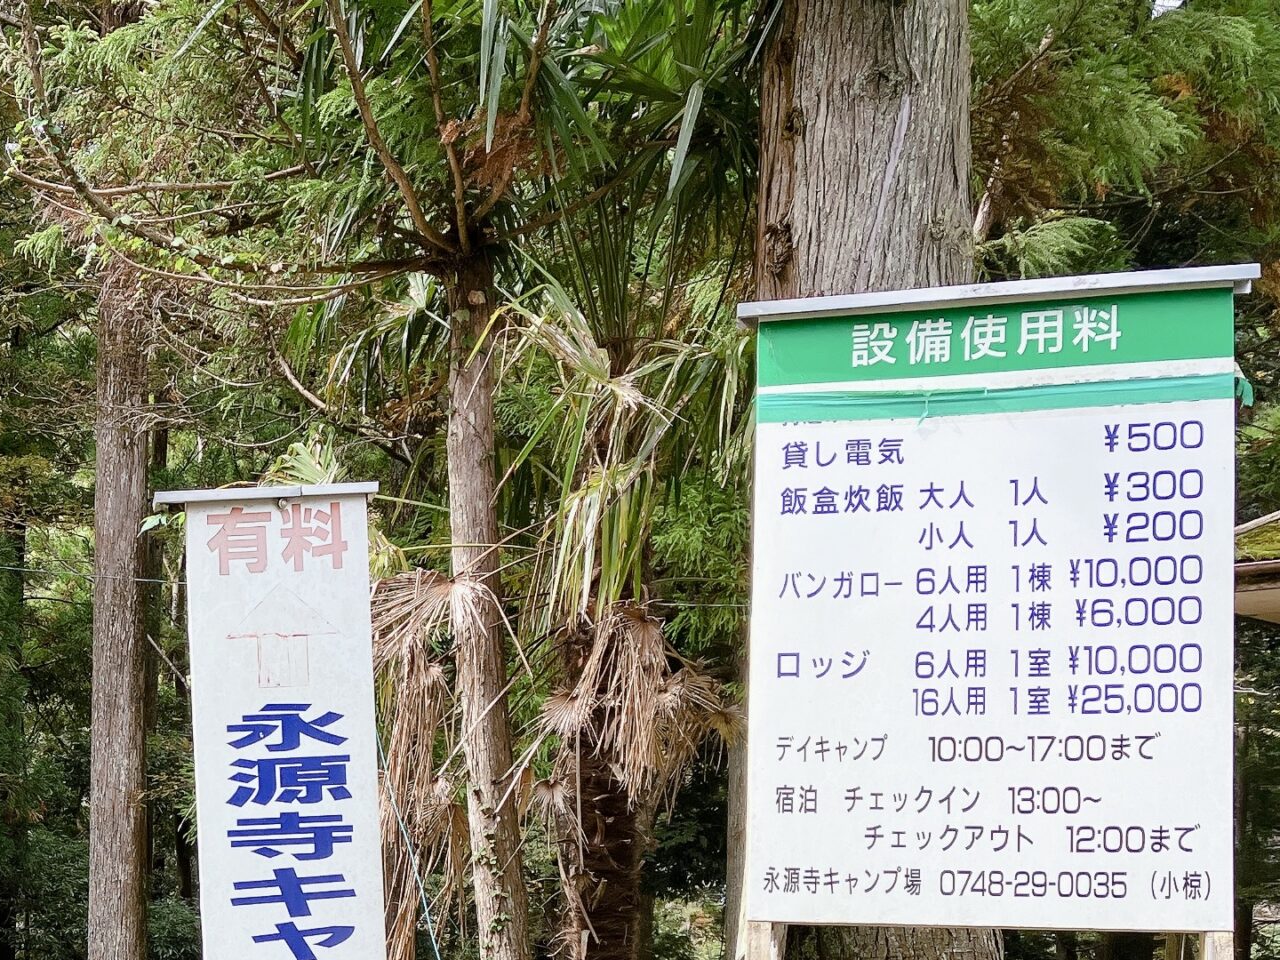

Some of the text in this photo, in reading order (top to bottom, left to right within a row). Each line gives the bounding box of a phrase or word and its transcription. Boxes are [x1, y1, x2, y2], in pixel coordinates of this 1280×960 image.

[851, 304, 1122, 368] 設備使用料
[781, 420, 1204, 470] 貸し電気 ¥500
[780, 468, 1204, 516] 飯盒炊飯 大人 1人 ¥300
[206, 502, 348, 576] 有料
[918, 509, 1204, 551] 小人 1人 ¥200
[778, 554, 1203, 599] バンガロー 6人用 1棟 ¥10,000
[915, 595, 1203, 633] 4人用 1棟 ¥6,000
[777, 642, 1203, 679] ロッジ 6人用 1室 ¥10,000
[912, 682, 1202, 716] 16人用 1室 ¥25,000
[776, 733, 888, 762] デイキャンプ
[775, 784, 818, 814] 宿泊
[844, 785, 980, 815] チェックイン
[864, 823, 1201, 854] チェックアウト 12:00まで
[763, 866, 922, 896] 永源寺キャンプ場
[939, 869, 1127, 899] 0748-29-0035
